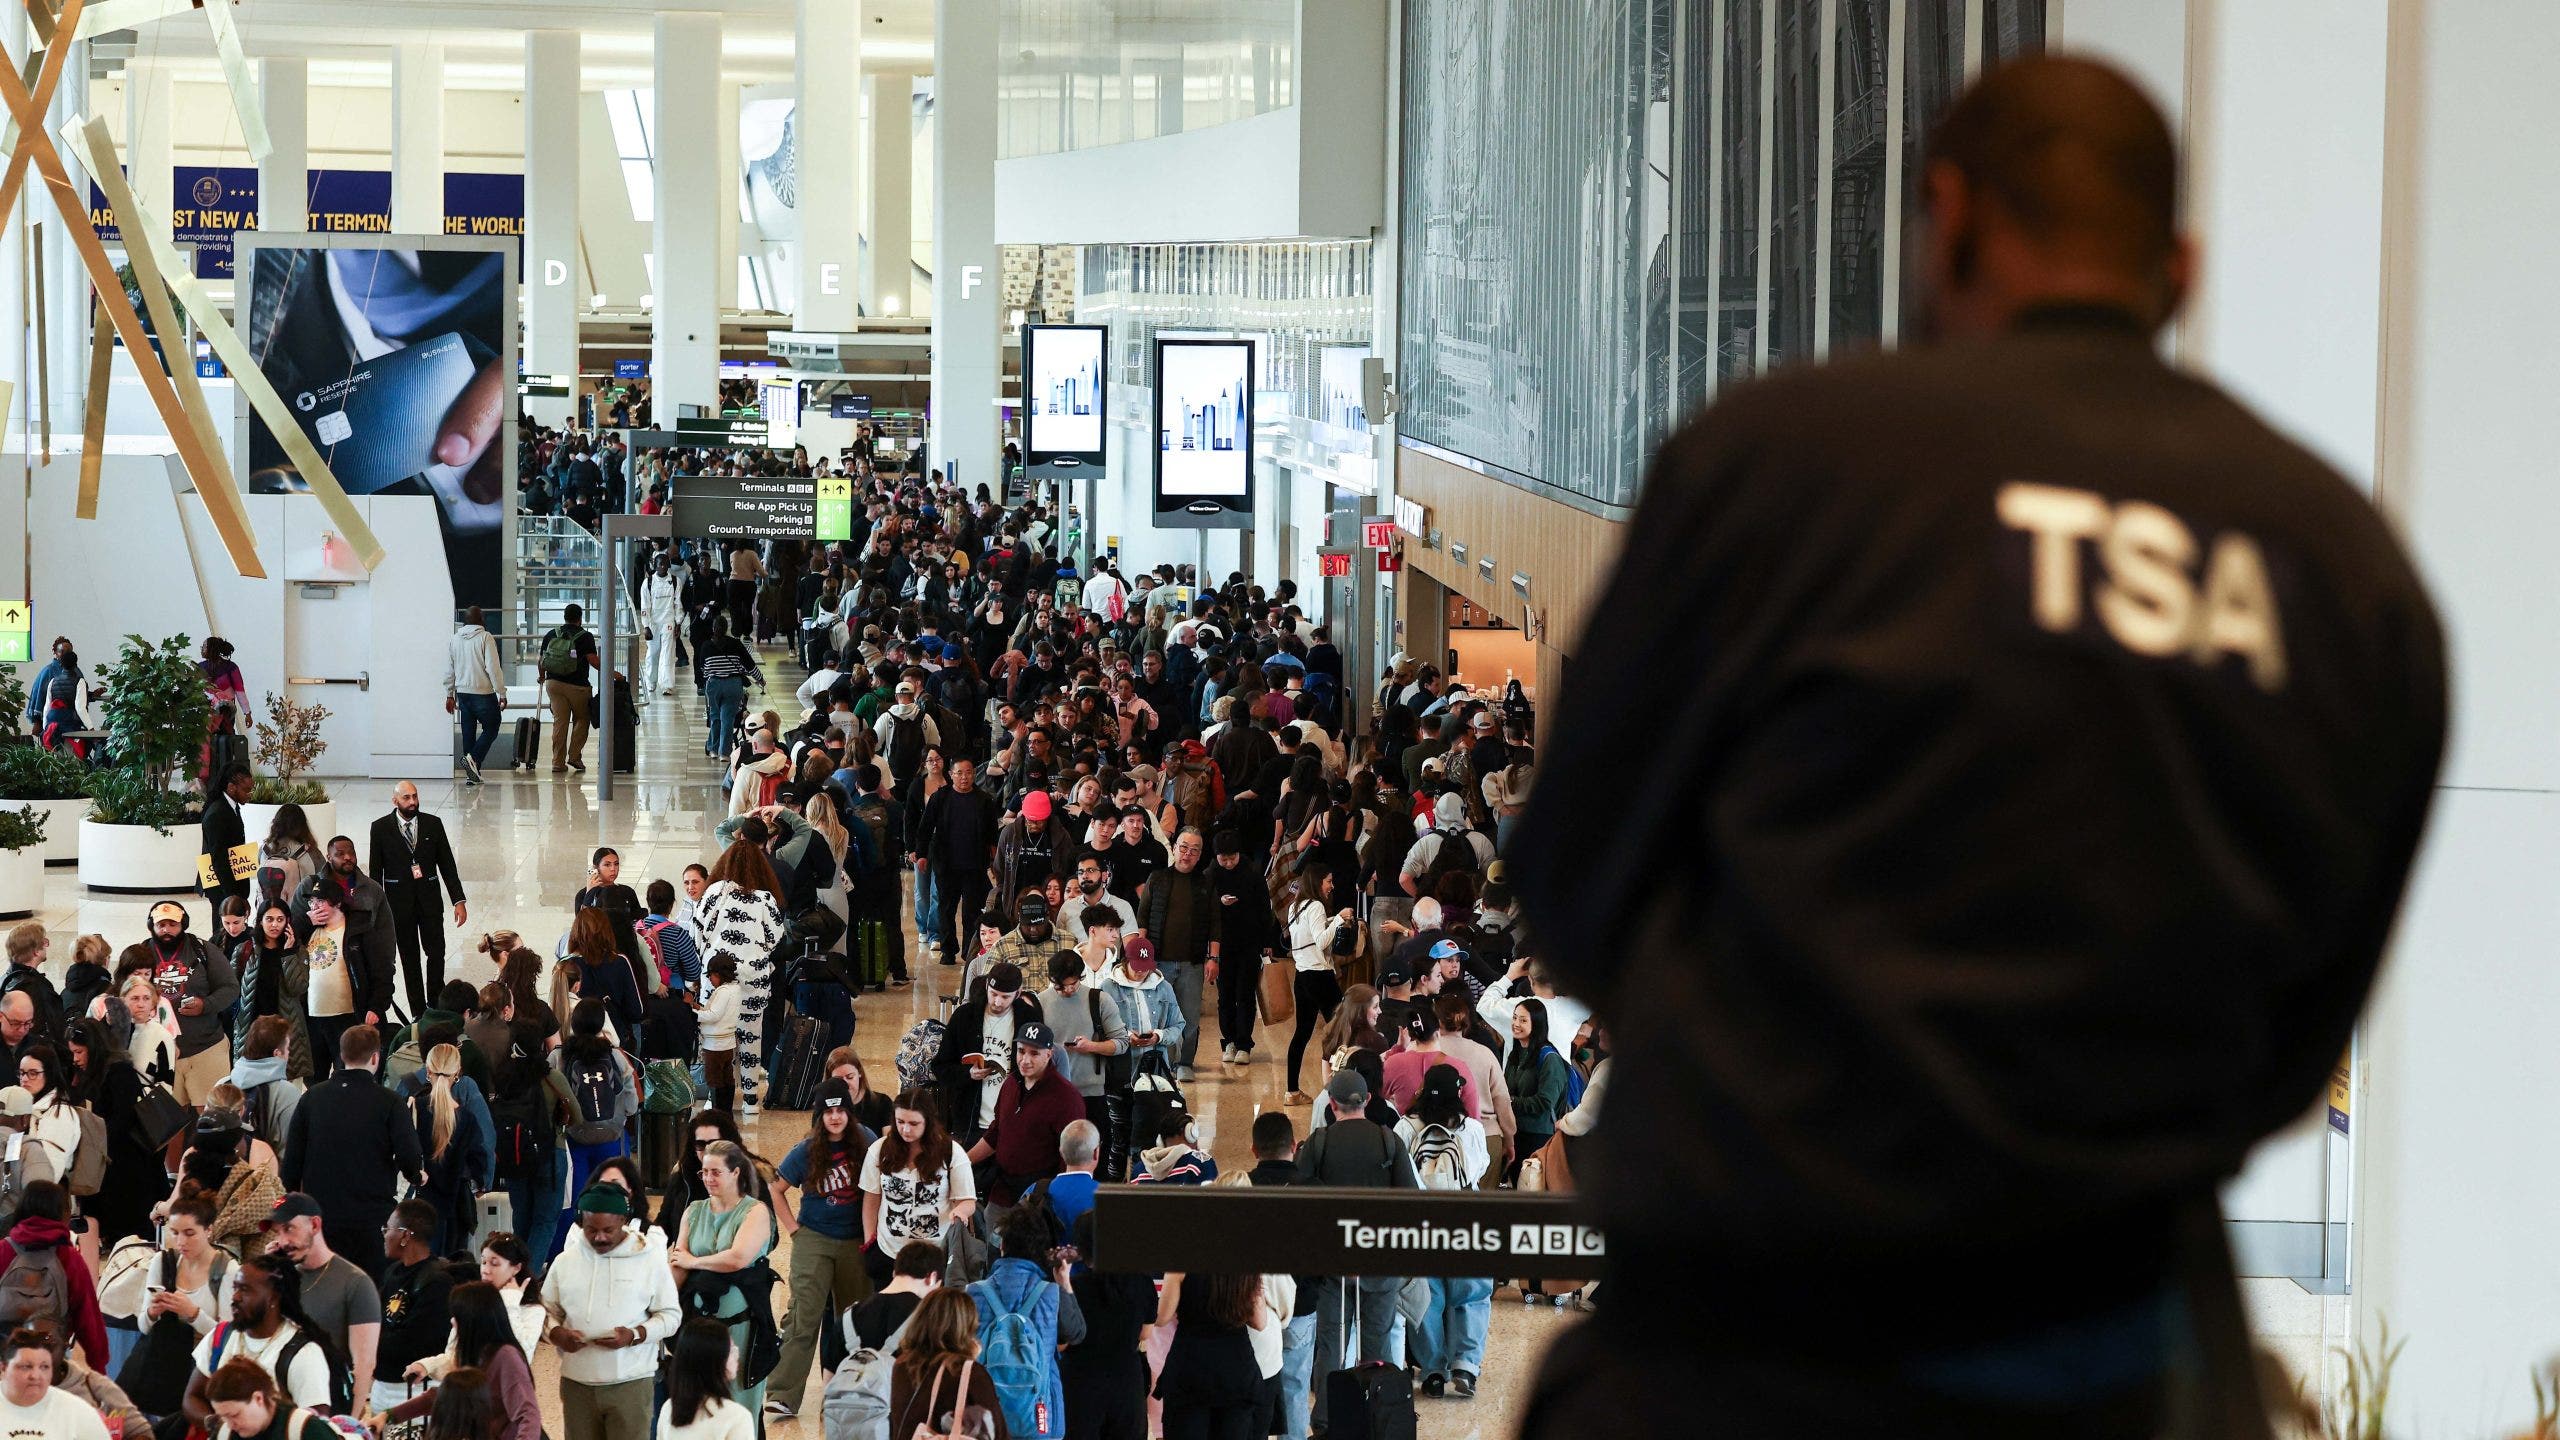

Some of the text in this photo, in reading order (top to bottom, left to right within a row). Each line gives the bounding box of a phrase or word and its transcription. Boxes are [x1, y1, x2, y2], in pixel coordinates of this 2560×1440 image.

[173, 210, 195, 228] ST
[200, 210, 240, 229] NEW
[244, 212, 258, 230] A
[443, 216, 466, 234] HE
[177, 233, 229, 242] demonstrate
[544, 260, 567, 286] D
[820, 263, 840, 295] E
[961, 265, 983, 300] F
[421, 342, 458, 359] BUSINESS
[620, 364, 640, 372] porter
[317, 370, 373, 396] SAPPHIRE
[320, 386, 358, 403] RESERVE
[740, 483, 785, 493] Terminals
[735, 502, 813, 513] Ride App Pick Up
[768, 515, 803, 526] Parking
[708, 524, 813, 536] Ground Transportation
[1998, 484, 2287, 691] TSA
[1337, 1218, 1501, 1252] Terminals
